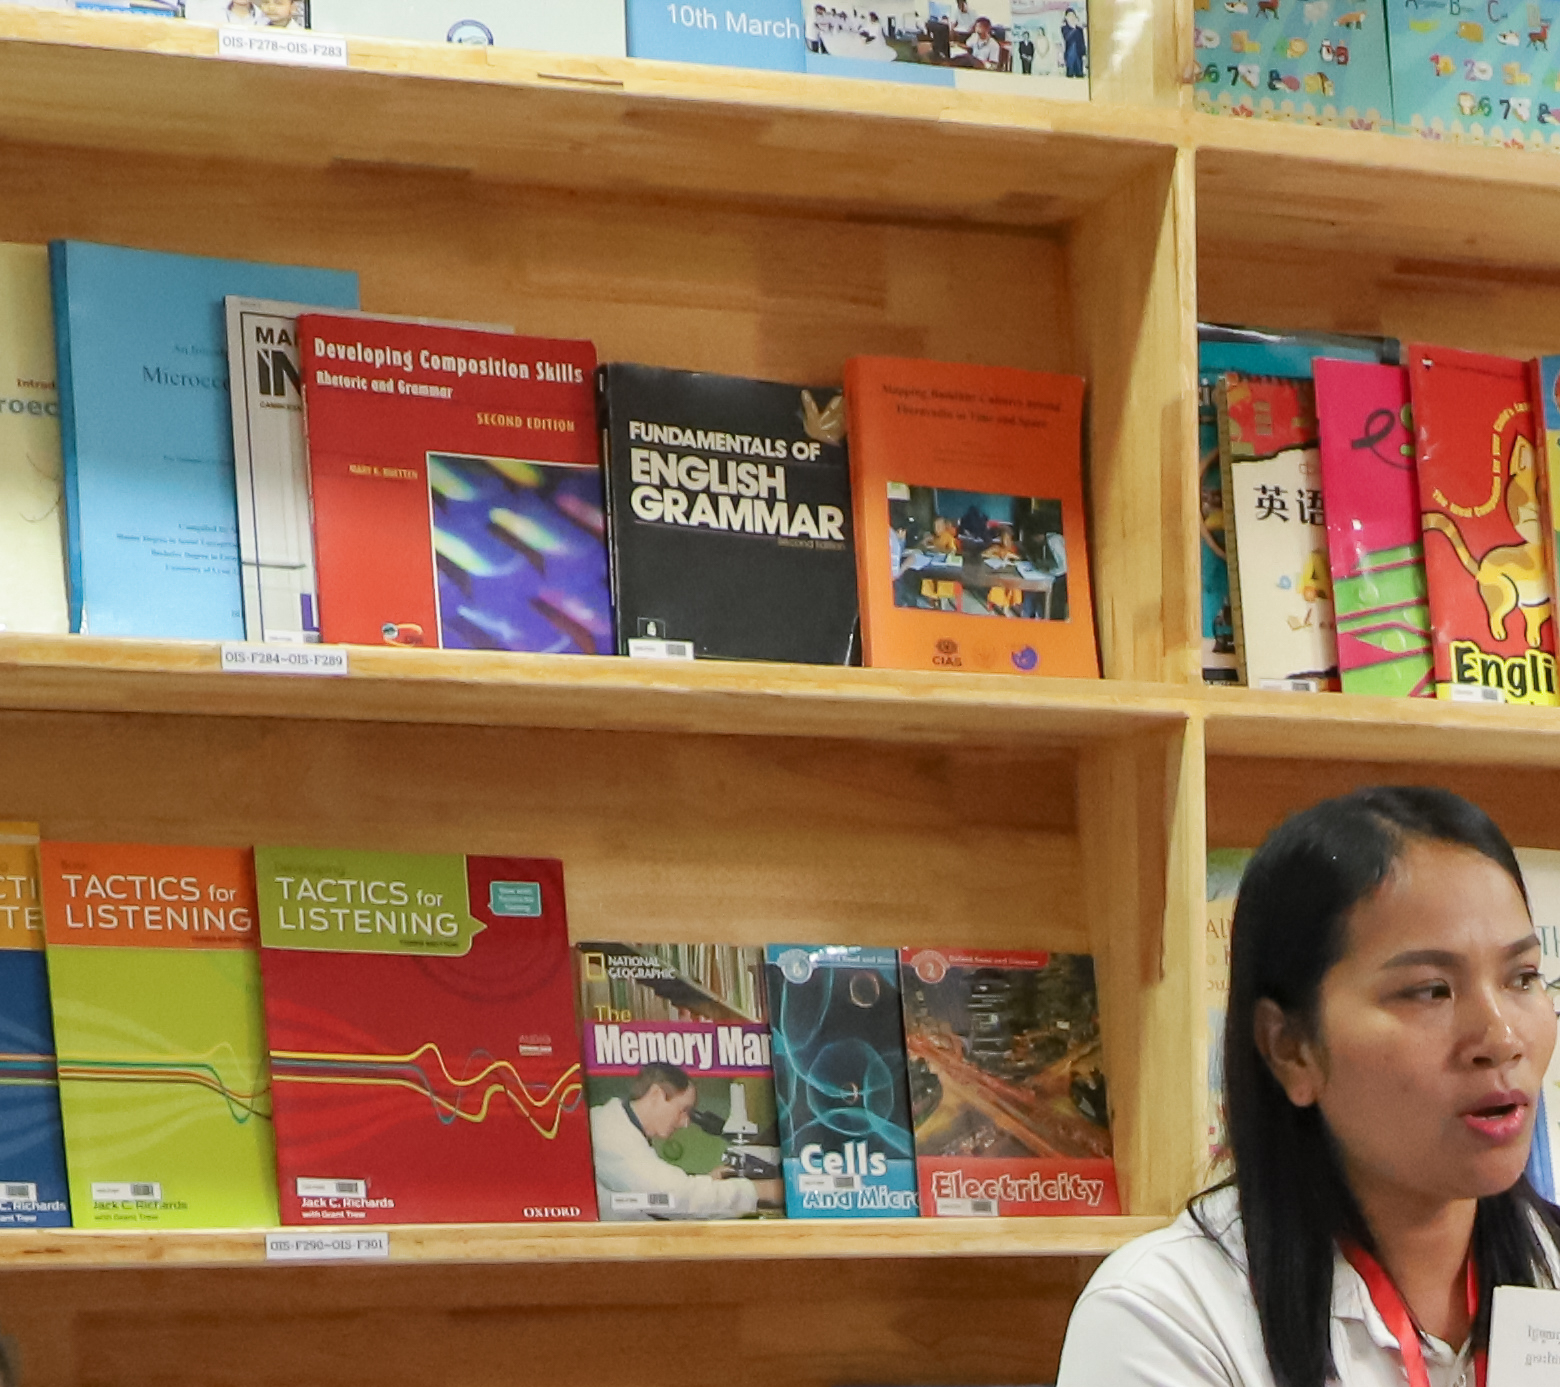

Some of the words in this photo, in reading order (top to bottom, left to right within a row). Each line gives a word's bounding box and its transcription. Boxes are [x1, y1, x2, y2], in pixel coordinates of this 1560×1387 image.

[667, 4, 718, 30] 10th
[726, 10, 801, 40] March
[314, 337, 414, 372] Developing
[420, 349, 530, 380] Composition
[535, 360, 584, 384] Skills
[316, 370, 367, 391] Rhetoric
[371, 379, 394, 394] and
[398, 380, 454, 399] Grammar
[476, 412, 523, 429] SECOND
[527, 417, 576, 432] EDITION
[629, 420, 787, 459] FUNDAMENTALS
[792, 440, 821, 462] OF
[630, 447, 786, 500] ENGLISH
[630, 485, 845, 541] GRAMMAR
[932, 655, 963, 667] CIAS
[1453, 646, 1556, 699] Engli
[61, 874, 201, 902] TACTICS
[208, 883, 236, 903] for
[274, 877, 410, 907] TACTICS
[416, 889, 444, 908] for
[65, 904, 253, 933] LISTENING
[278, 905, 459, 938] LISTENING
[608, 955, 661, 968] NATIONAL
[608, 966, 676, 980] GEOGRAPHIC
[595, 1005, 633, 1022] The
[593, 1024, 714, 1070] Memory
[800, 1142, 887, 1176] Cells
[301, 1197, 327, 1209] Jack
[342, 1196, 395, 1209] Richards
[803, 1187, 852, 1210] And
[931, 1170, 1105, 1207] Electricity
[13, 1201, 67, 1213] Richards
[93, 1200, 120, 1210] Jack
[135, 1200, 189, 1211] Richards
[522, 1206, 581, 1219] OXFORD
